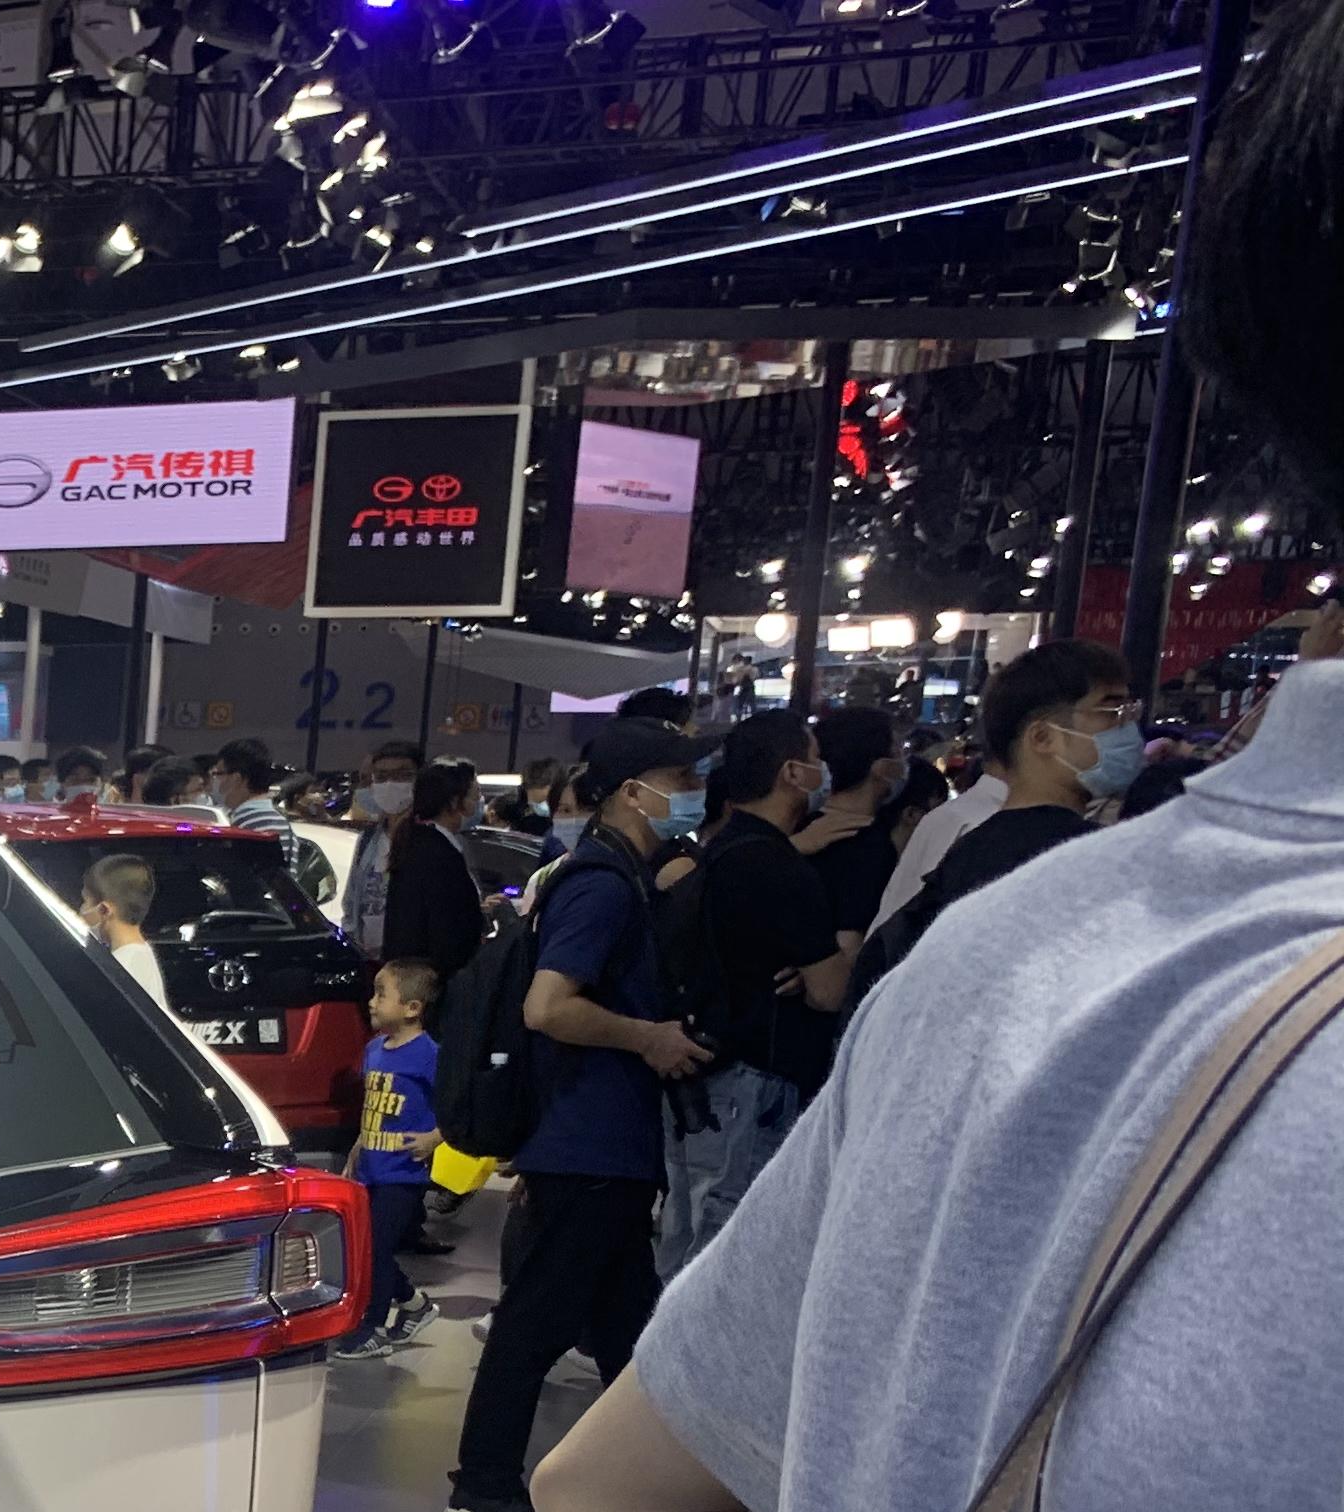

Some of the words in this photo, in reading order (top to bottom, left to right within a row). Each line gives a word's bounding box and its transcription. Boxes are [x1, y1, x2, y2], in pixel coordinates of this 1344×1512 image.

[62, 449, 255, 484] 广汽传祺
[61, 484, 126, 502] GAC
[134, 479, 253, 500] MOTOR
[351, 506, 480, 529] 广汽丰田
[296, 668, 395, 730] 2.2
